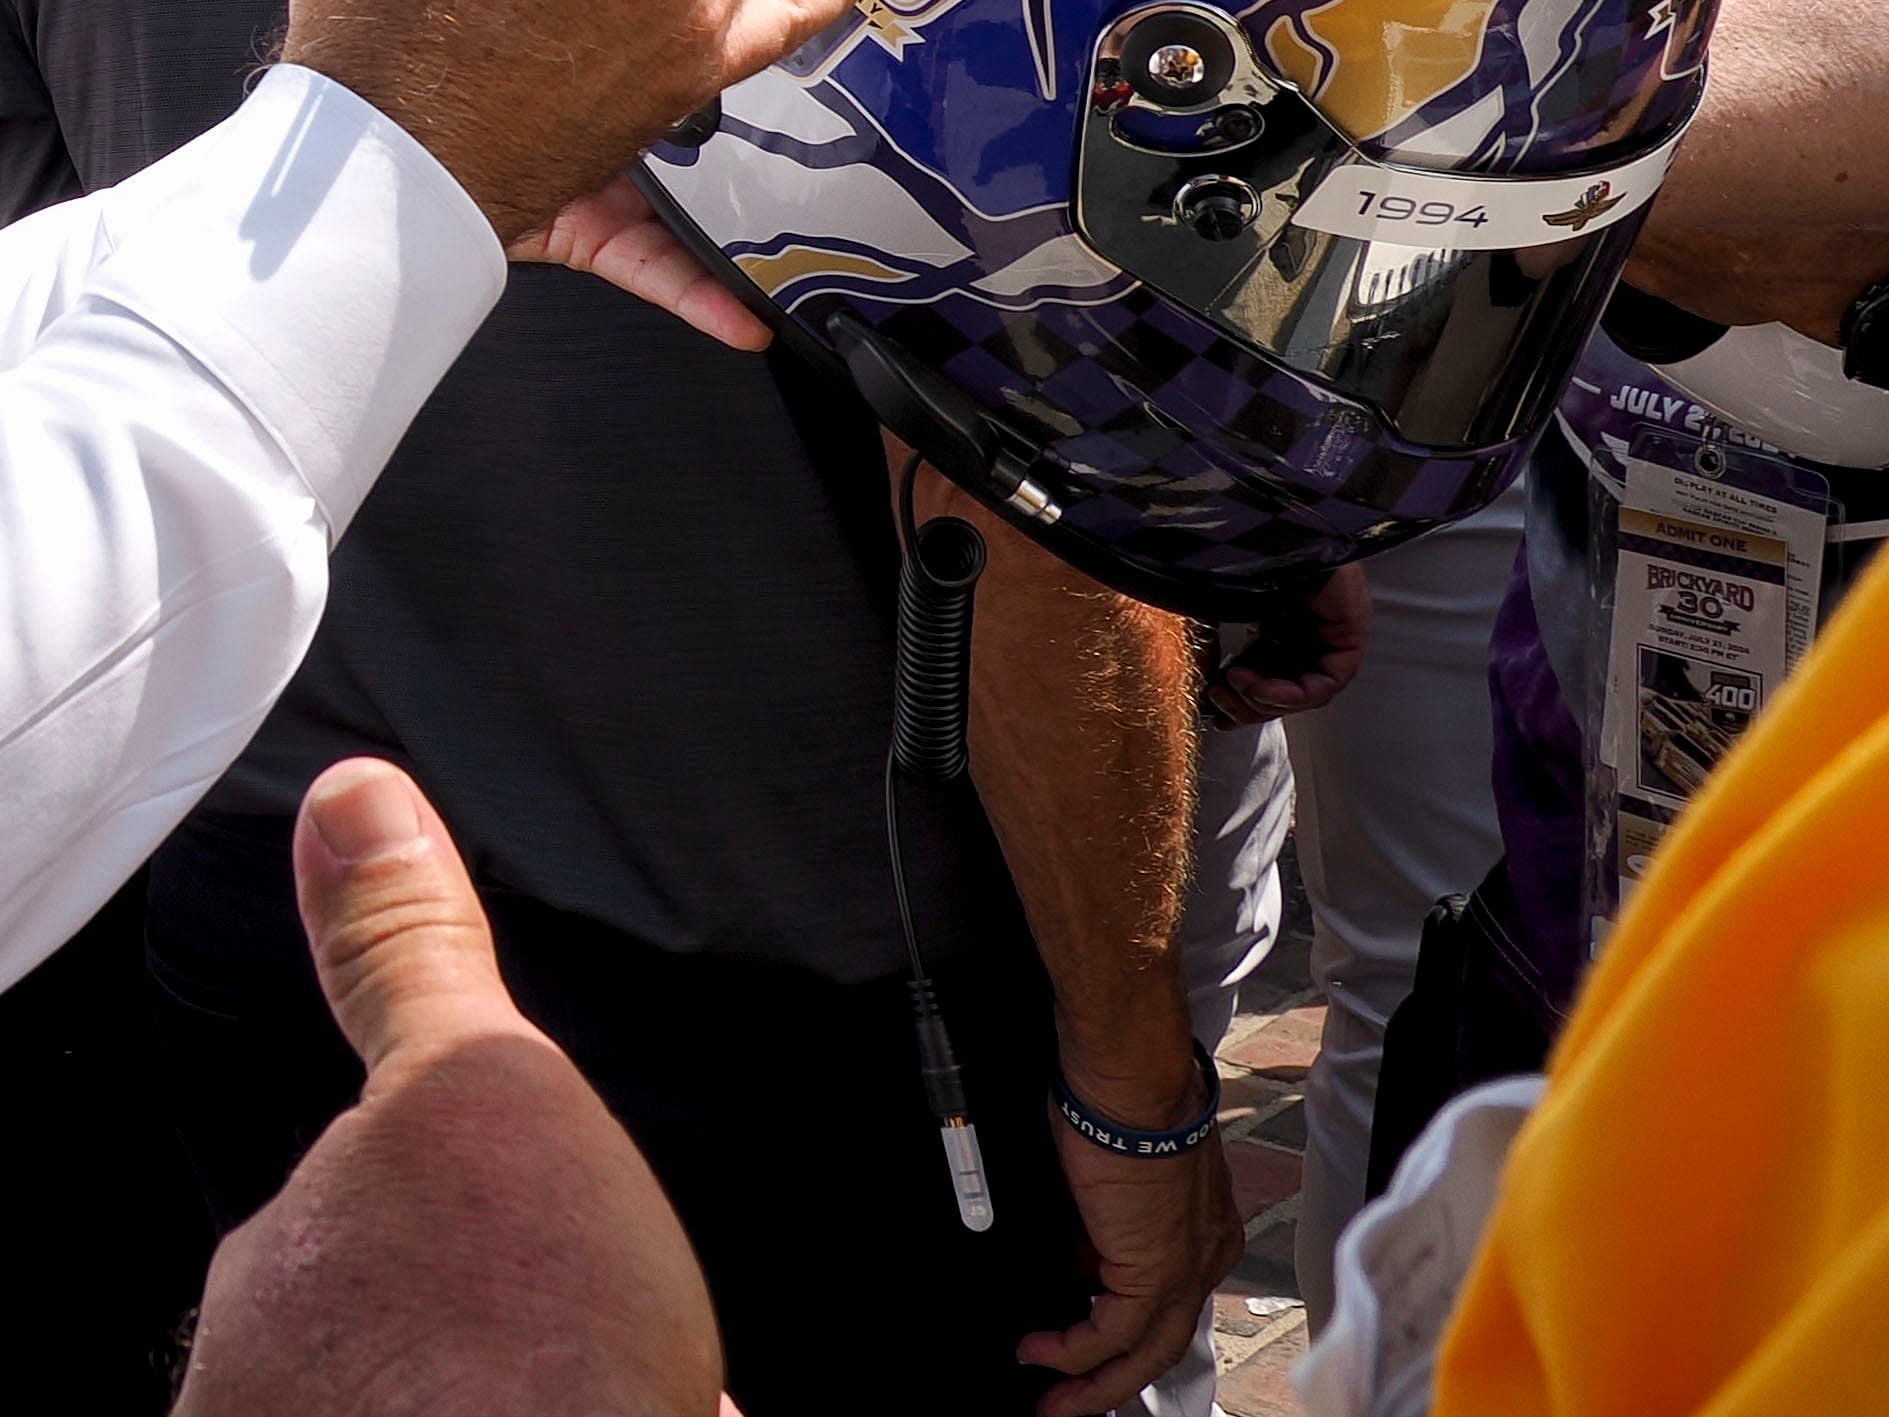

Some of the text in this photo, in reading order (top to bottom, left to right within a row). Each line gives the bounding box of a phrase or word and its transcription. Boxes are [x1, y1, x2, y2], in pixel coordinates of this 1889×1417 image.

[1358, 190, 1489, 229] 1994
[1610, 385, 1685, 424] JULY
[1656, 522, 1748, 553] ADMIT ONE
[1646, 563, 1755, 613] BRICKYARD
[1676, 590, 1724, 620] 30
[1705, 682, 1756, 711] 400
[1061, 1101, 1214, 1154] OD WE TRUST
